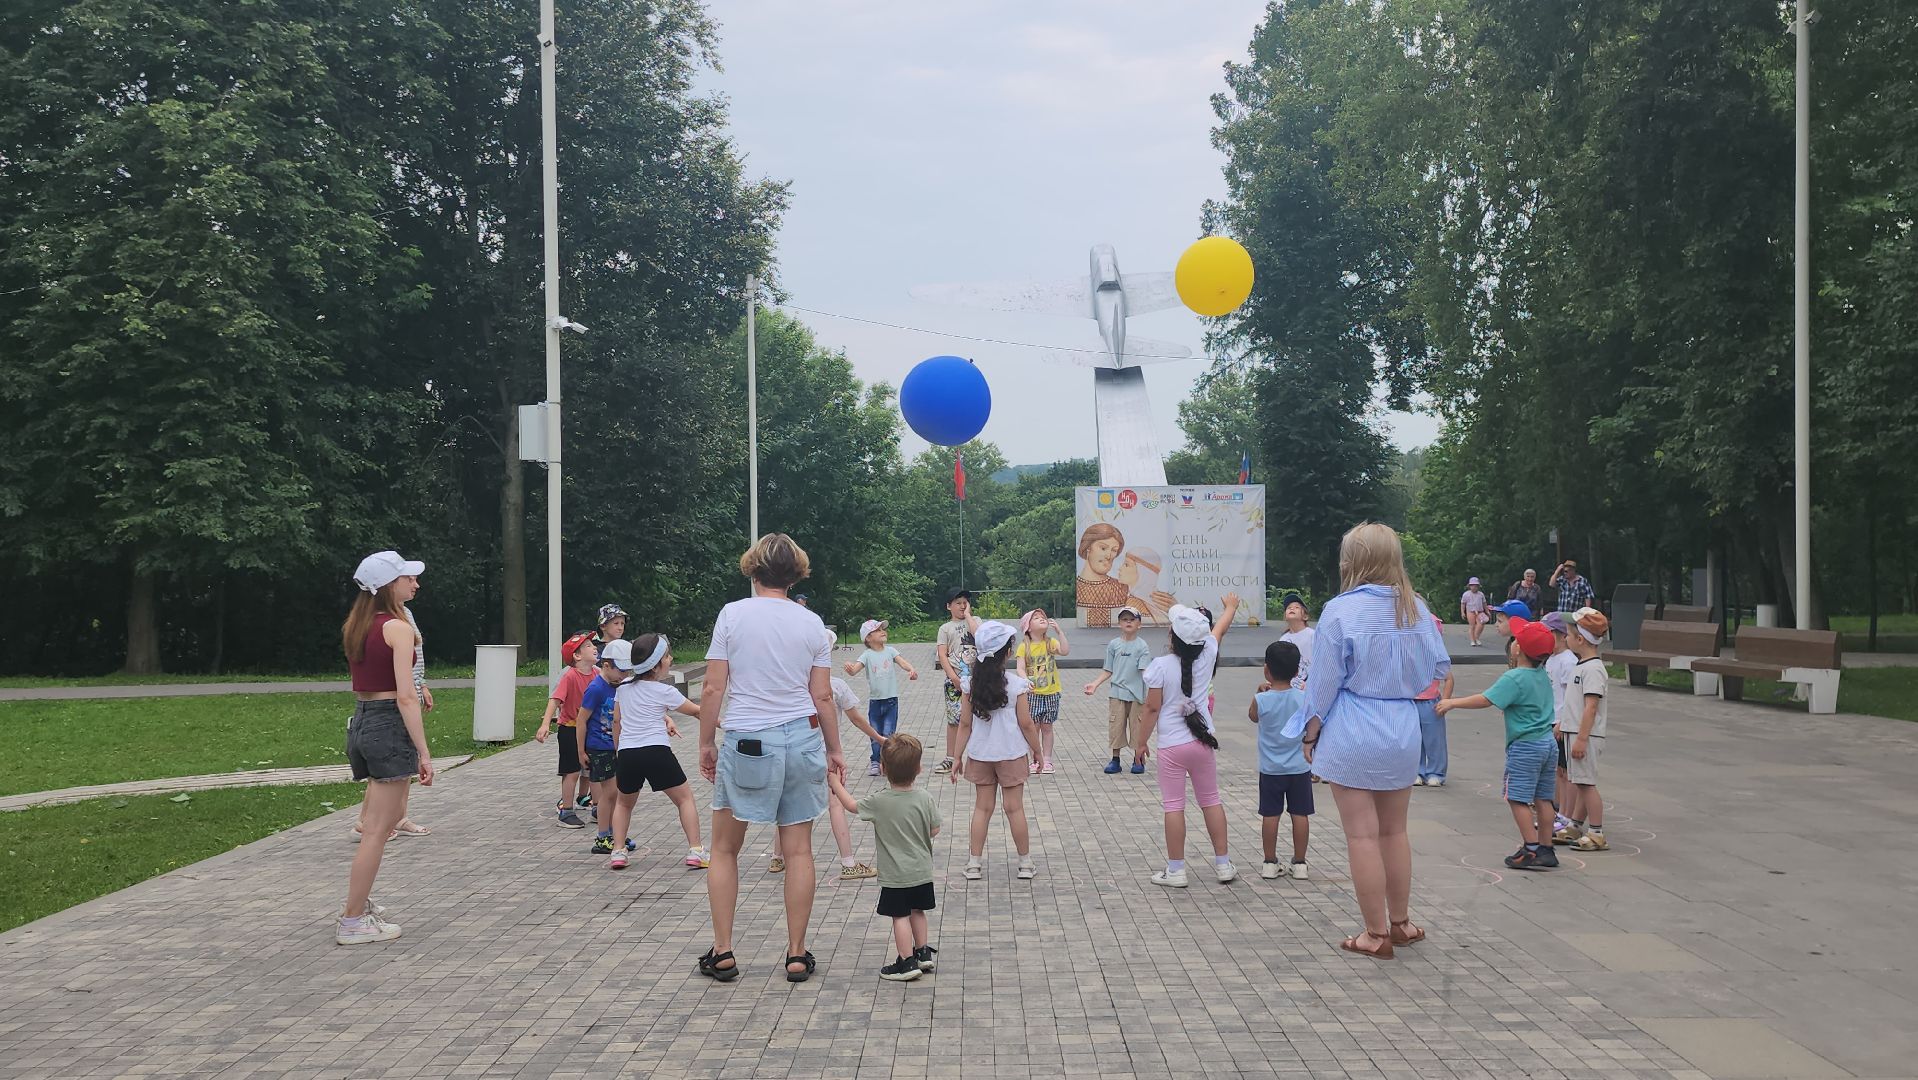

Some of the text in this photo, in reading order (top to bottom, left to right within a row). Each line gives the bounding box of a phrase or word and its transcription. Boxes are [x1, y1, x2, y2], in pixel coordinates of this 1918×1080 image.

[1171, 534, 1208, 545] ДЕНЬ
[1171, 562, 1220, 574] ЛЮБВИ
[1172, 575, 1259, 588] И ВЕРНОСТИ
